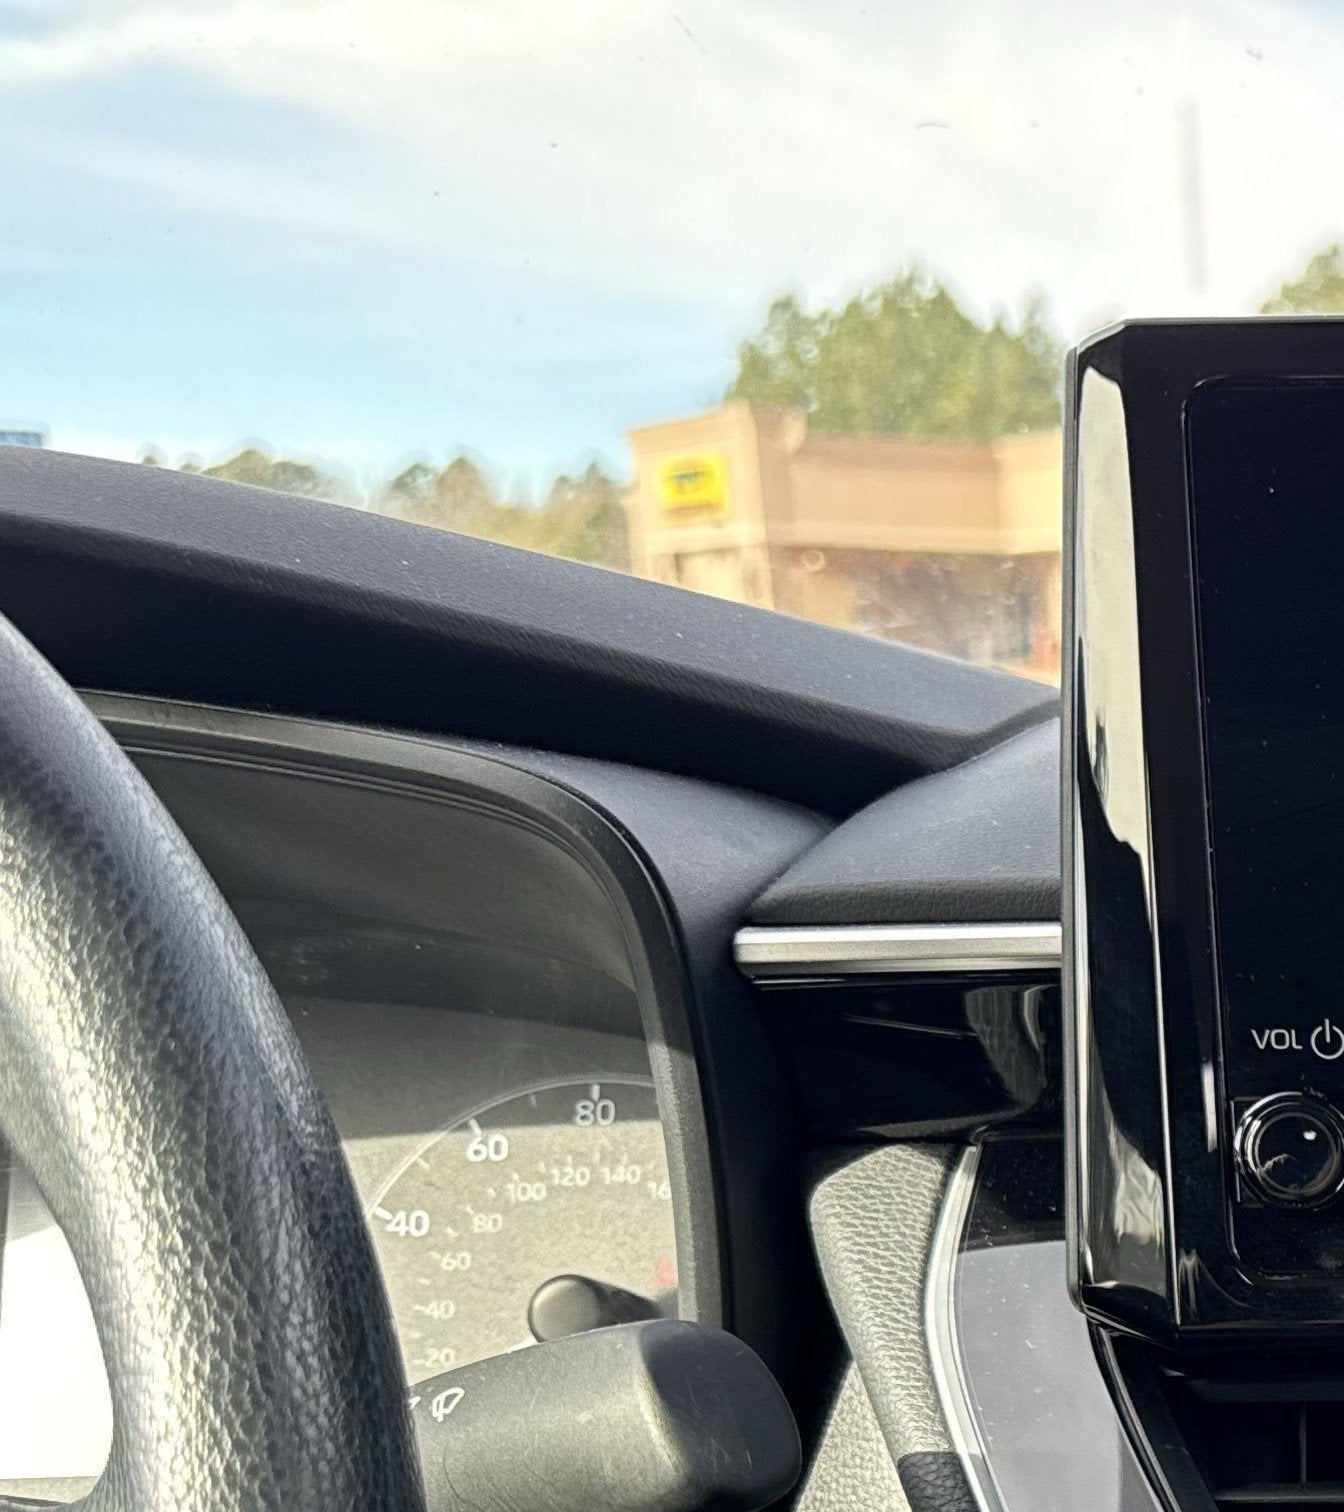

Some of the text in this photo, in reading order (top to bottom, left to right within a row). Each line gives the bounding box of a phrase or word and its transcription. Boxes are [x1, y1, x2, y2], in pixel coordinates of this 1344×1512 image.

[1251, 1028, 1303, 1050] VOL
[574, 1098, 616, 1126] 80
[465, 1134, 508, 1163] 60
[550, 1165, 591, 1187] 120
[600, 1163, 642, 1185] 140
[505, 1181, 547, 1202] 100
[646, 1181, 672, 1201] 16
[384, 1210, 430, 1237] 40
[472, 1212, 503, 1234] 80
[440, 1251, 472, 1272] 60
[425, 1300, 456, 1319] 40
[425, 1347, 456, 1368] 20
